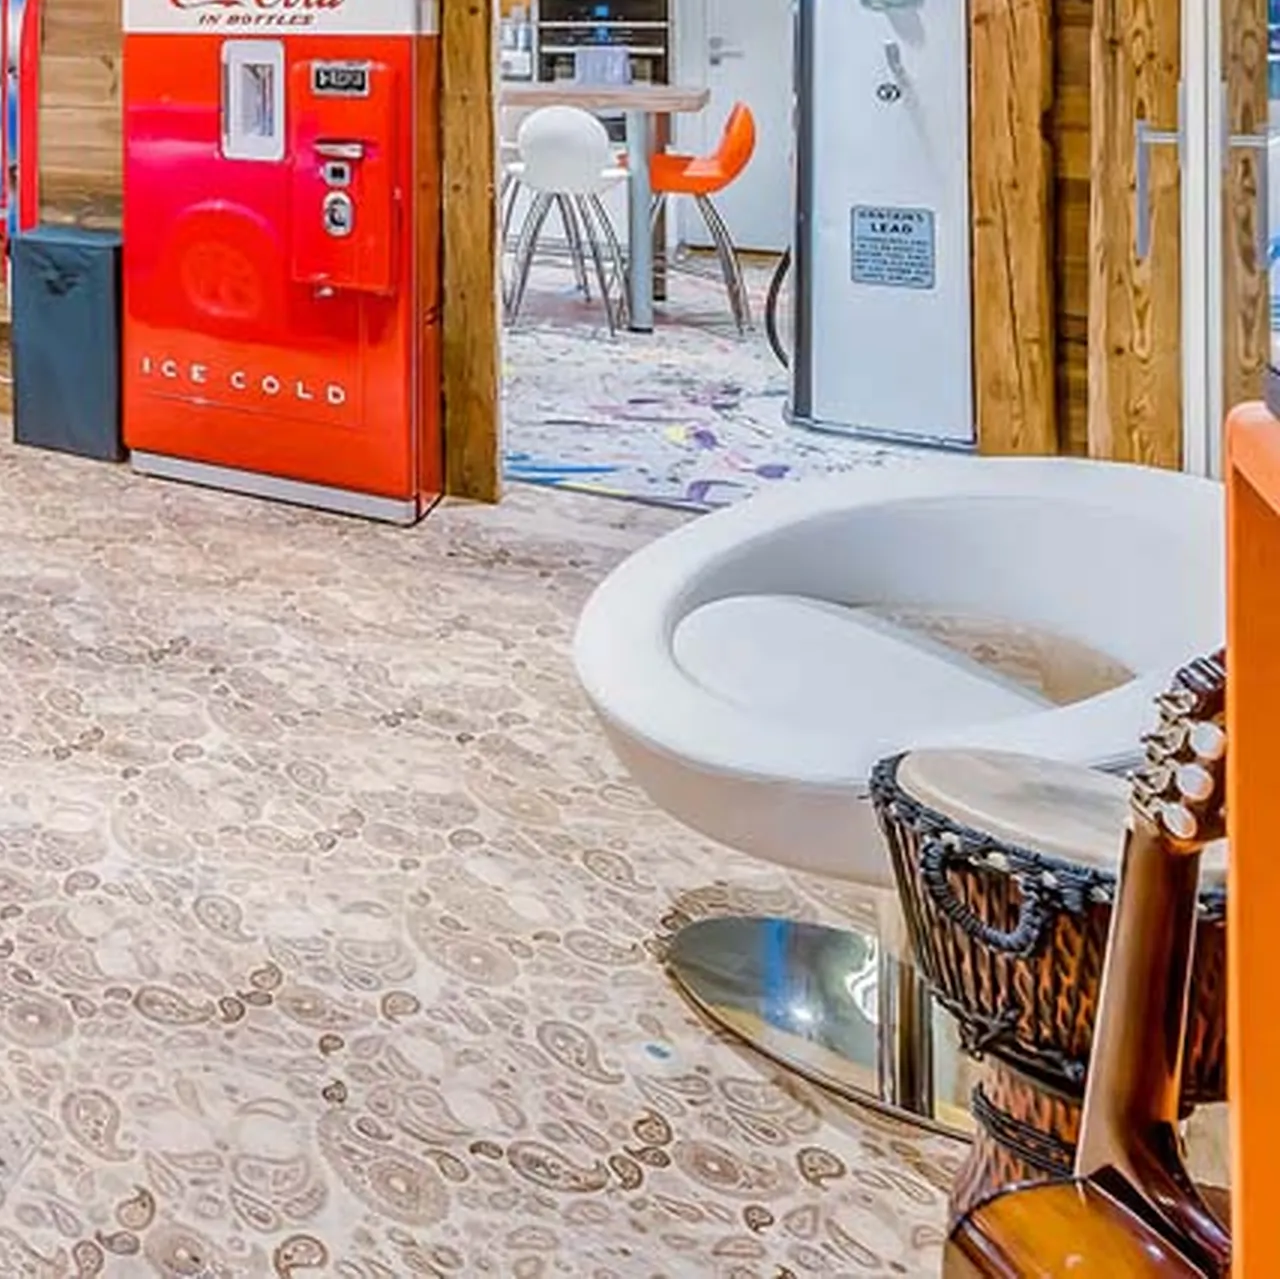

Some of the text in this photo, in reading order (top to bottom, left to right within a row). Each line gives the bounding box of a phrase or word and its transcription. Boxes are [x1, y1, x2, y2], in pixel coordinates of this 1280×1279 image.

[199, 14, 315, 26] IN BOTTLES
[870, 222, 913, 234] LEAD
[141, 356, 346, 405] ICE COLD
